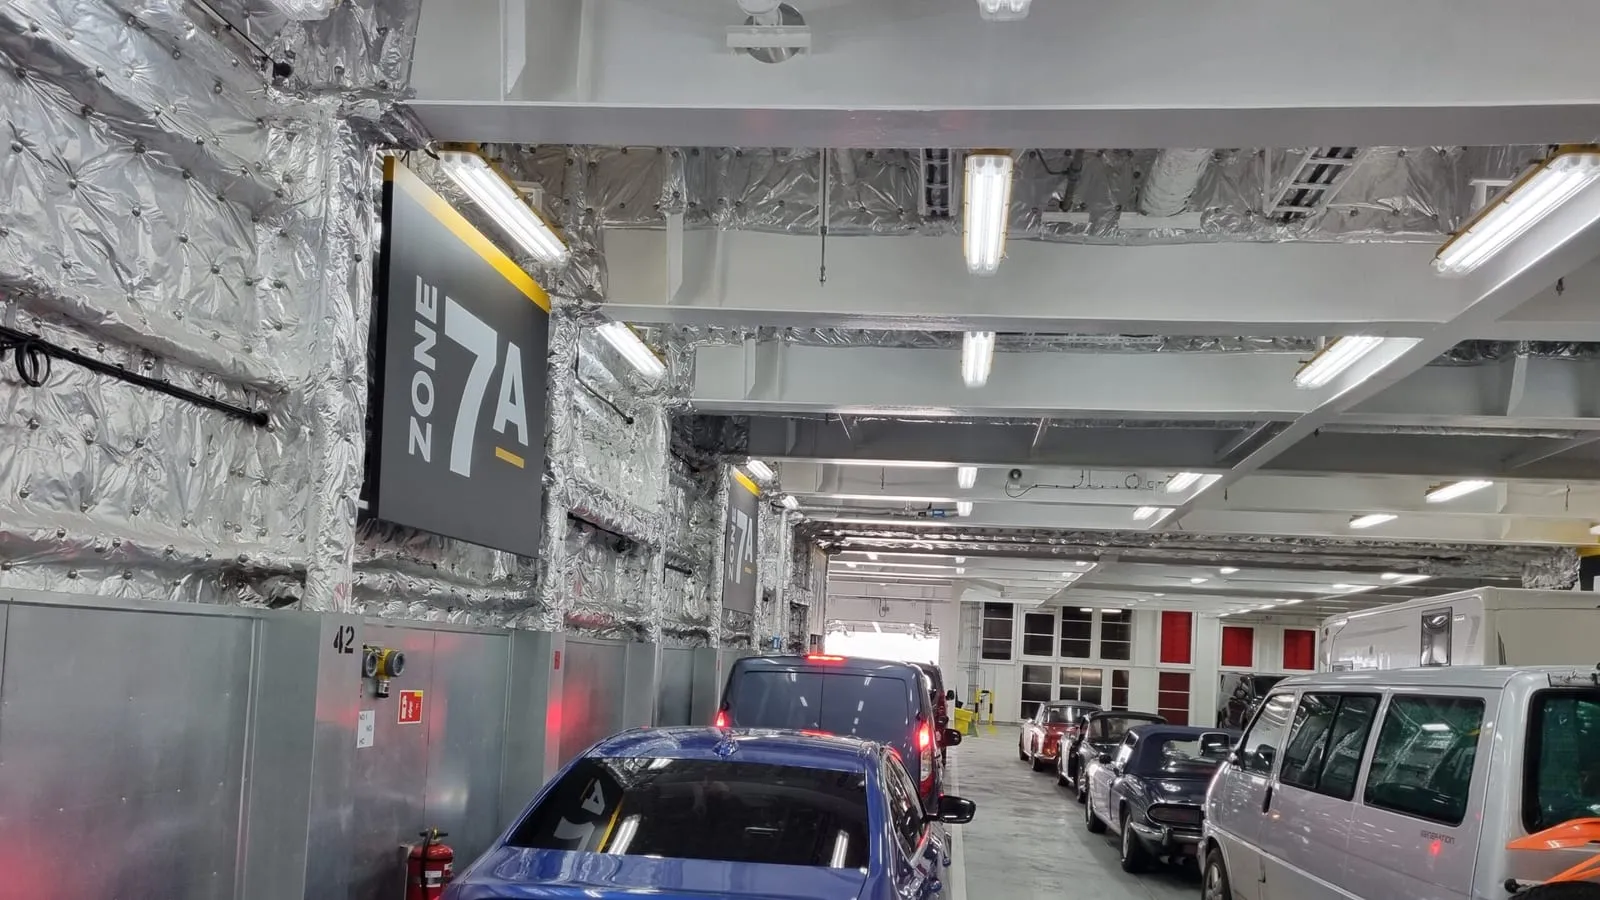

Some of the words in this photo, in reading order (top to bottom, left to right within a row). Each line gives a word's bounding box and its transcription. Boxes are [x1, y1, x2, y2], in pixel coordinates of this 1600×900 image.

[408, 275, 438, 463] ZONE
[444, 295, 529, 478] 7A
[736, 509, 752, 584] 7A
[333, 625, 355, 654] 42
